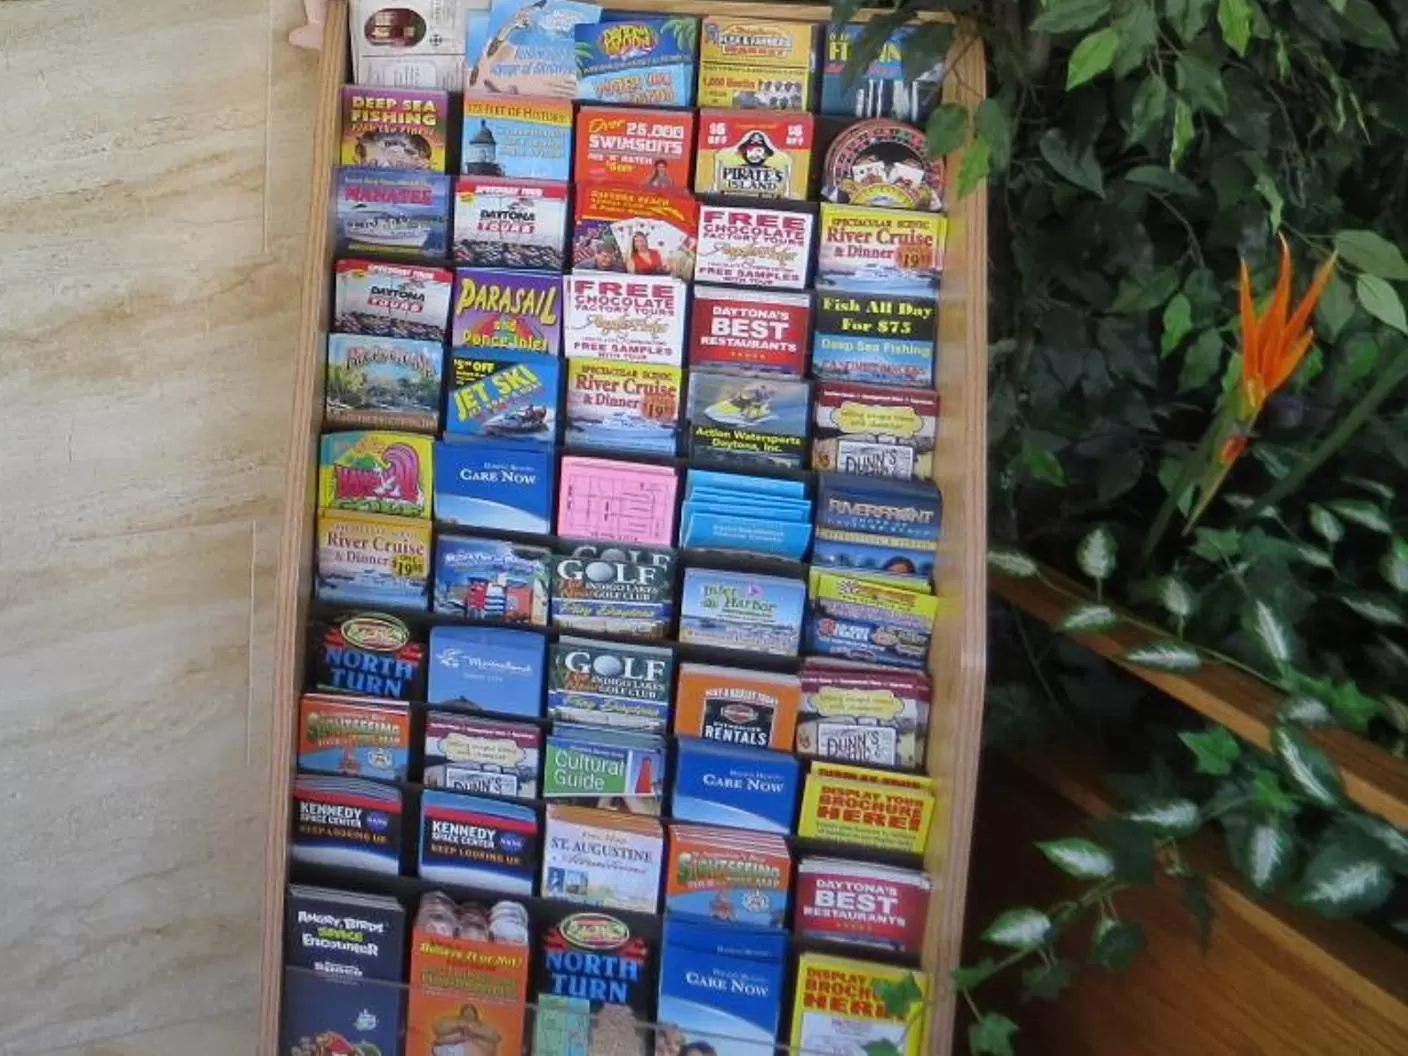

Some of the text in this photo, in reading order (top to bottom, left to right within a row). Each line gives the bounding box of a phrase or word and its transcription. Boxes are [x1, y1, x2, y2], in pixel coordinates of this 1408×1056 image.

[352, 96, 436, 113] DEEP SEA
[351, 109, 437, 126] FISHING
[588, 118, 626, 134] Over
[588, 134, 684, 155] SWIMSUITS
[722, 167, 784, 182] PIRATE'S
[727, 180, 777, 191] ISLAND
[480, 209, 535, 222] DAYTONA
[703, 210, 806, 230] FREE
[479, 222, 535, 234] TOURS
[703, 224, 805, 241] CHOCOLATE
[827, 226, 934, 247] River Cruise
[703, 233, 804, 246] FACTORY TOURS
[847, 244, 895, 260] Dinner
[699, 266, 800, 282] FREE SAMPLES
[370, 286, 425, 302] DAYTONA
[574, 279, 675, 299] FREE
[368, 298, 423, 313] TOURS
[456, 277, 557, 326] PARASAIL
[574, 295, 675, 310] CHOCOLATE
[574, 304, 675, 317] FACTORY TOURS
[823, 296, 934, 320] Fish All Day
[712, 305, 790, 322] DAYTONA'S
[711, 317, 790, 340] BEST
[841, 317, 913, 335] For $75
[463, 330, 508, 348] Ponce
[699, 335, 797, 353] RESTAURANTS
[821, 338, 932, 359] Deep Sea Fishing
[573, 342, 674, 357] FREE SAMPLES
[473, 362, 495, 373] OFF
[453, 363, 544, 423] JET SKI
[575, 374, 676, 398] River Cruise
[595, 392, 641, 409] Dinner
[695, 427, 801, 446] Action Watersports
[712, 438, 783, 453] Daytona, Inc.
[845, 447, 897, 474] DUNN'S
[459, 468, 537, 486] CARE NOW
[827, 498, 934, 524] RIVERFRONT
[327, 532, 425, 556] River Cruise
[345, 550, 388, 567] Dinner
[557, 558, 657, 586] GOLF
[623, 592, 651, 601] CLUB
[324, 646, 415, 680] NORTH
[564, 651, 666, 682] GOLF
[331, 668, 403, 698] TURN
[633, 680, 665, 692] LAKES
[628, 689, 658, 700] CLUB
[704, 725, 768, 747] RENTALS
[826, 730, 880, 758] DUNN'S
[554, 748, 625, 777] Cultural
[553, 769, 606, 791] Guide
[702, 773, 743, 789] CARE
[746, 777, 785, 793] NOW
[819, 794, 923, 817] BROCHURE
[821, 786, 924, 808] DISPLAY YOUR
[300, 801, 363, 820] KENNEDY
[816, 806, 921, 832] HERE!
[300, 815, 362, 829] SPACE CENTER
[431, 820, 497, 840] KENNEDY
[431, 832, 495, 850] SPACE CENTER
[431, 843, 458, 856] KEEP
[459, 847, 504, 863] LOOKING
[571, 842, 653, 863] AUGUSTINE
[815, 879, 898, 897] DAYTONA'S
[814, 889, 899, 915] BEST
[802, 906, 906, 928] RESTAURANTS
[420, 942, 463, 961] Believe
[545, 948, 640, 983] NORTH
[550, 971, 629, 1005] TURN
[685, 970, 728, 991] CARE
[730, 978, 770, 998] NOW
